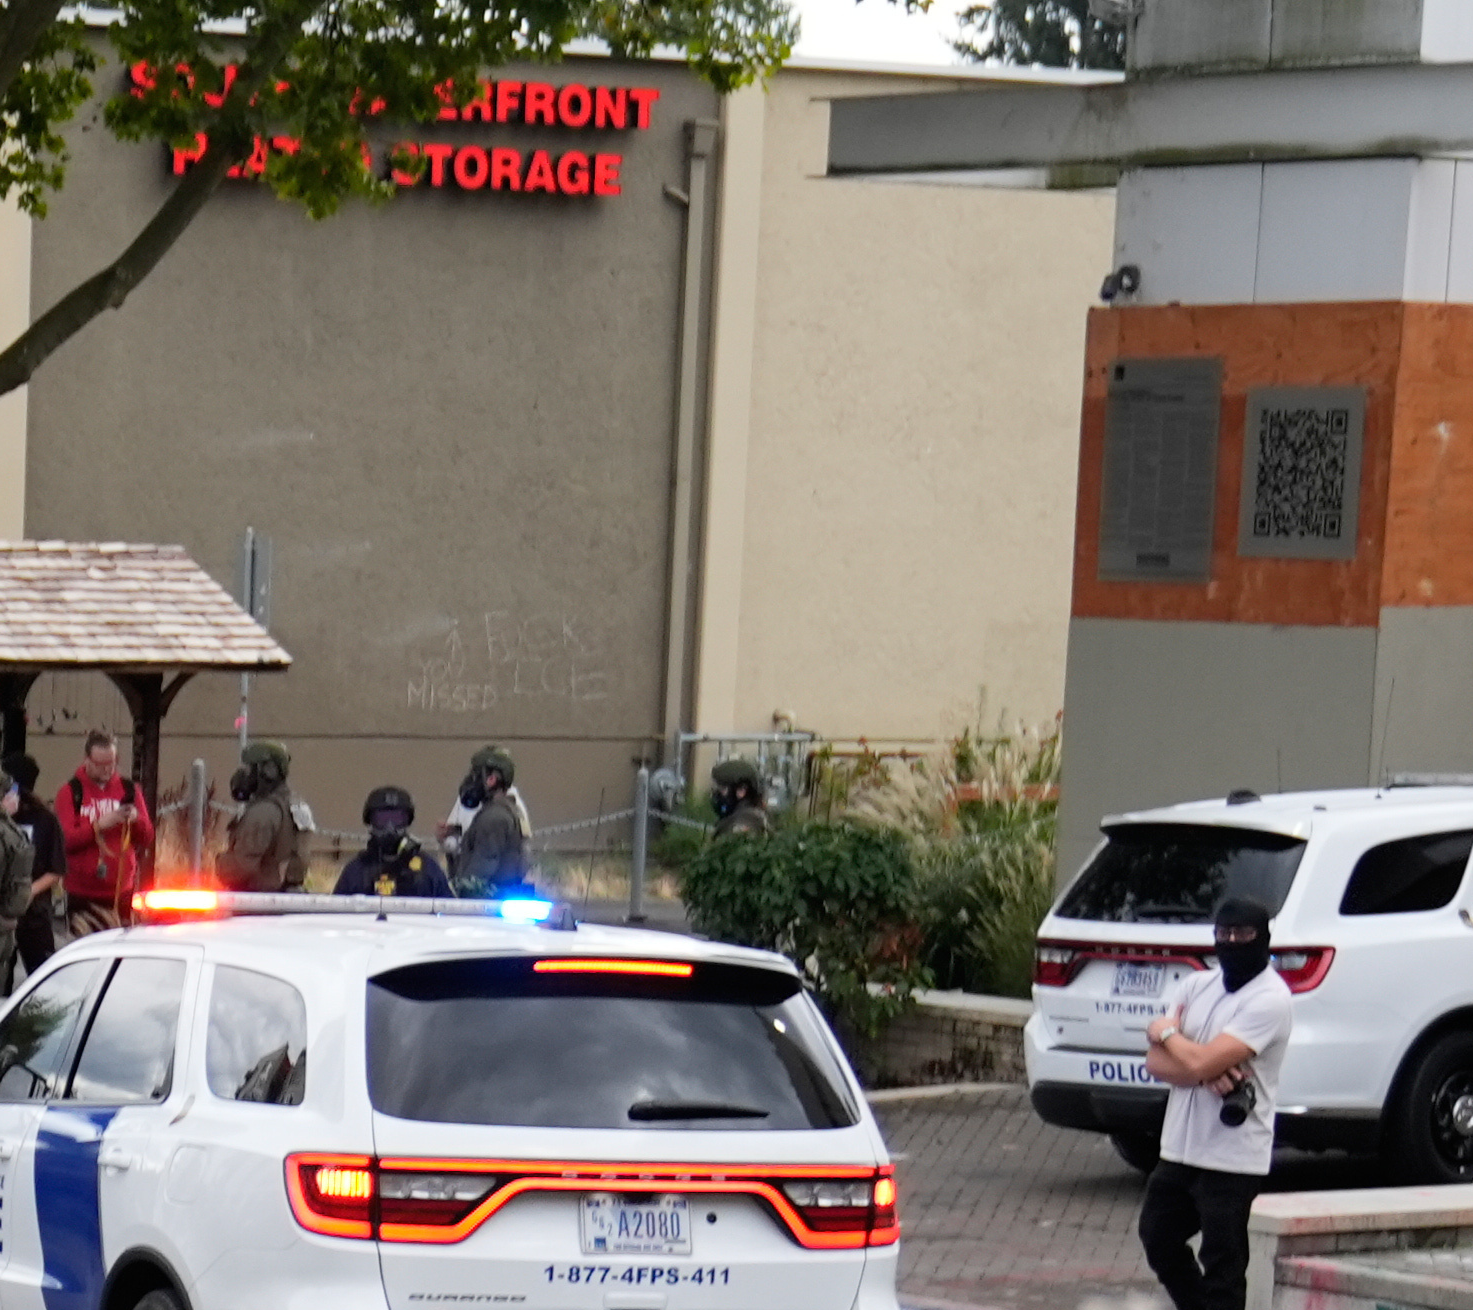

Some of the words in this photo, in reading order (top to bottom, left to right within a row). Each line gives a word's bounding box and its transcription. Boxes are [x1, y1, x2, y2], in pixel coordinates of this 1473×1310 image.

[407, 675, 498, 711] MISSED
[1089, 1061, 1162, 1083] POLIC
[618, 1209, 680, 1240] A2080
[544, 1265, 730, 1286] 1-877-4FPS-411
